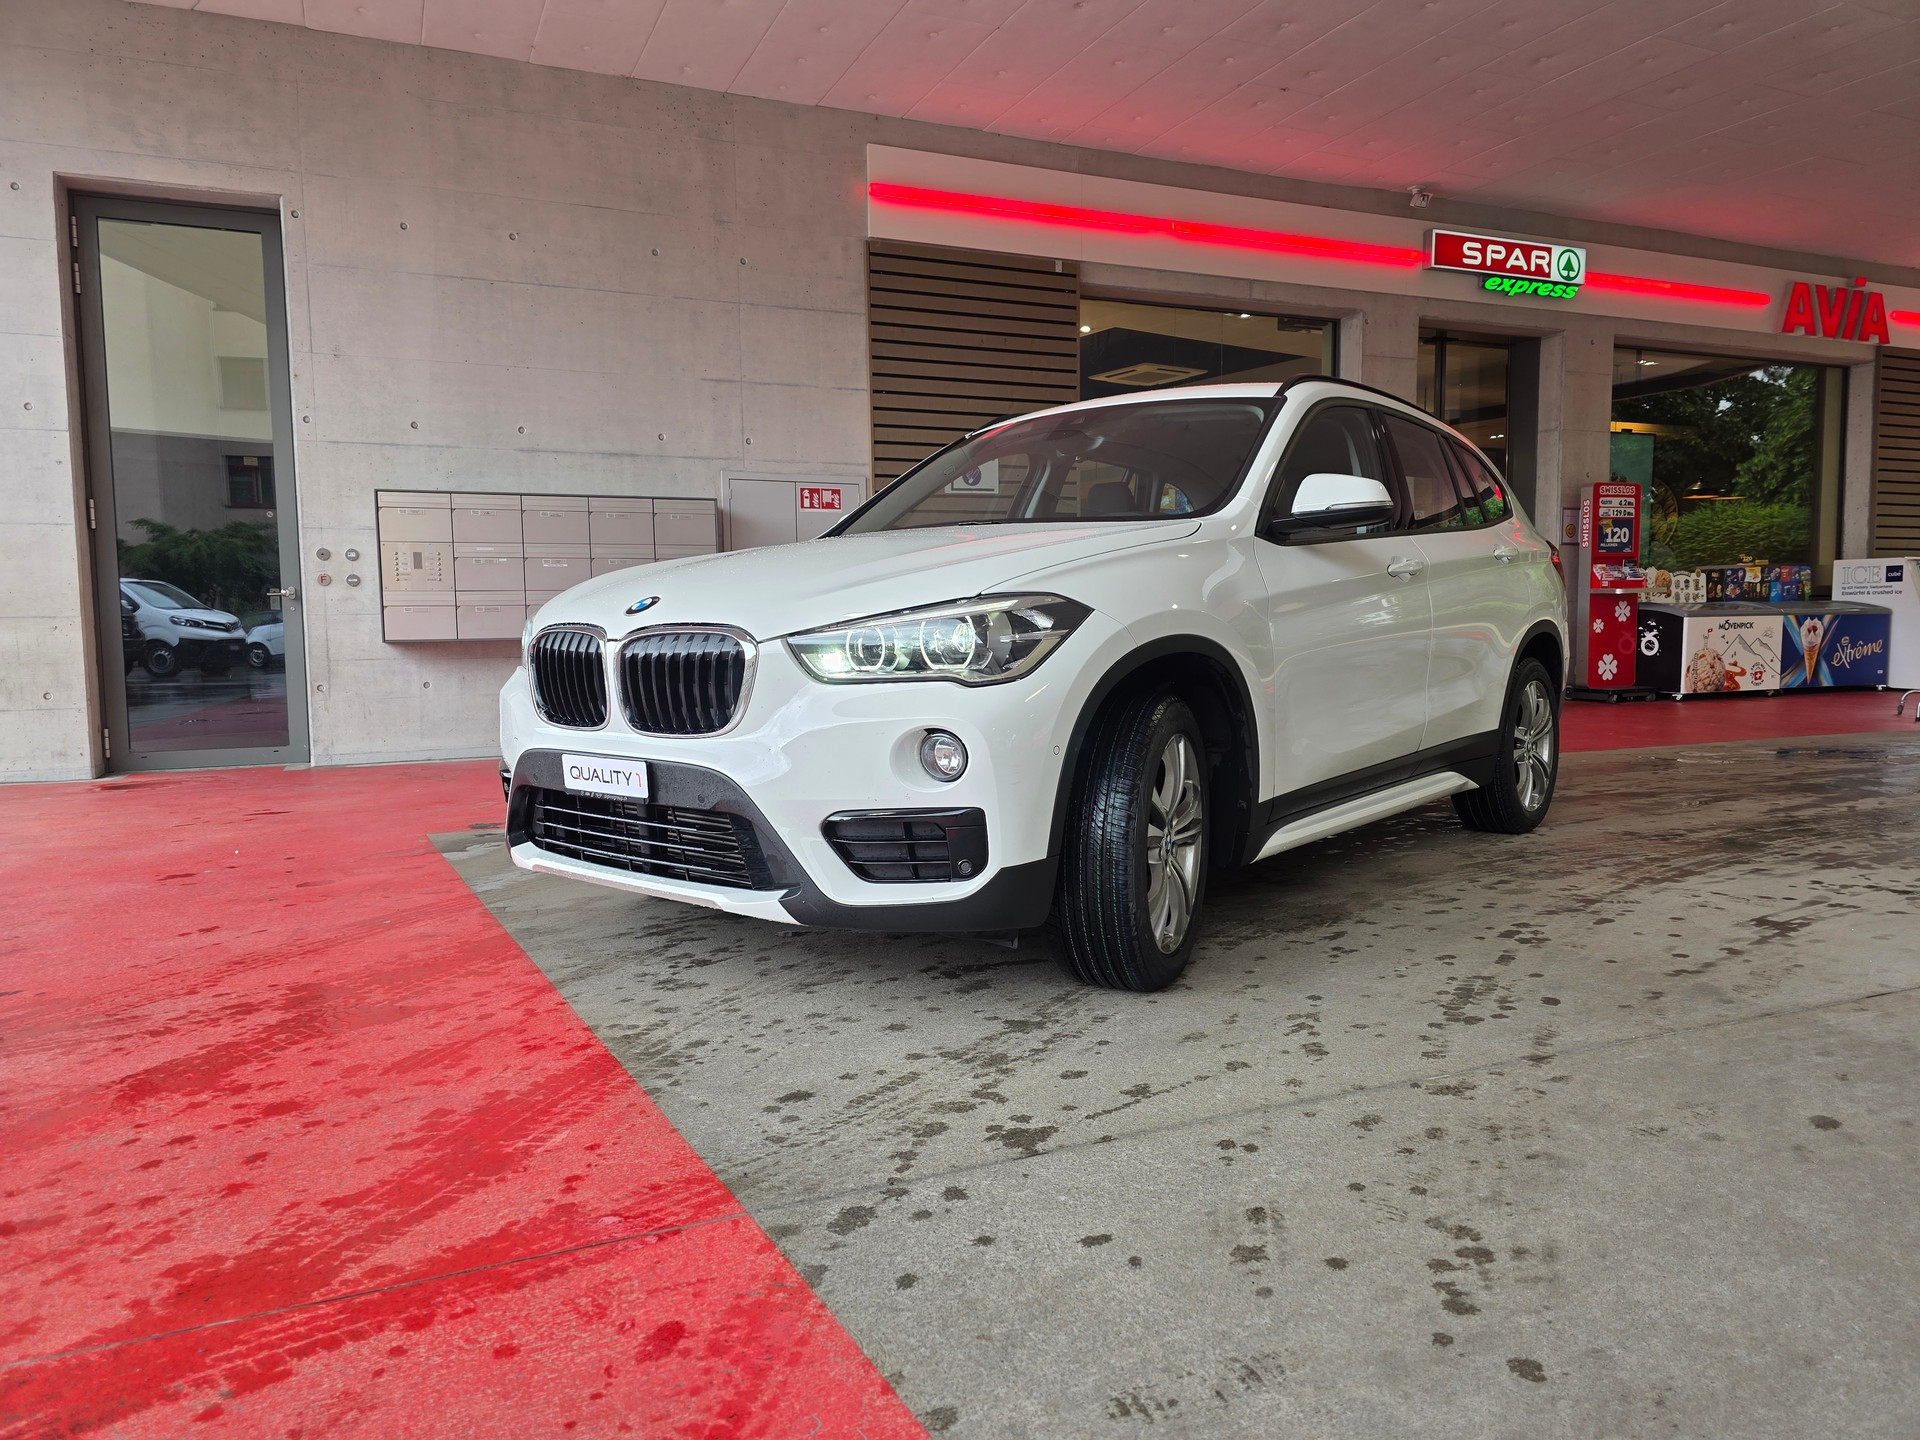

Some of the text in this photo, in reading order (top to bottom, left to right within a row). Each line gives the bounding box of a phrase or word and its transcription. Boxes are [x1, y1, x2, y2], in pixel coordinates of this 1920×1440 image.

[1462, 241, 1550, 273] SPAR
[1484, 276, 1579, 299] express
[1600, 486, 1635, 495] SWISSLOS
[1582, 500, 1590, 547] SWISSLOS
[1605, 527, 1630, 543] 120
[1842, 566, 1882, 584] ICE
[569, 766, 642, 788] QUALITY 1
